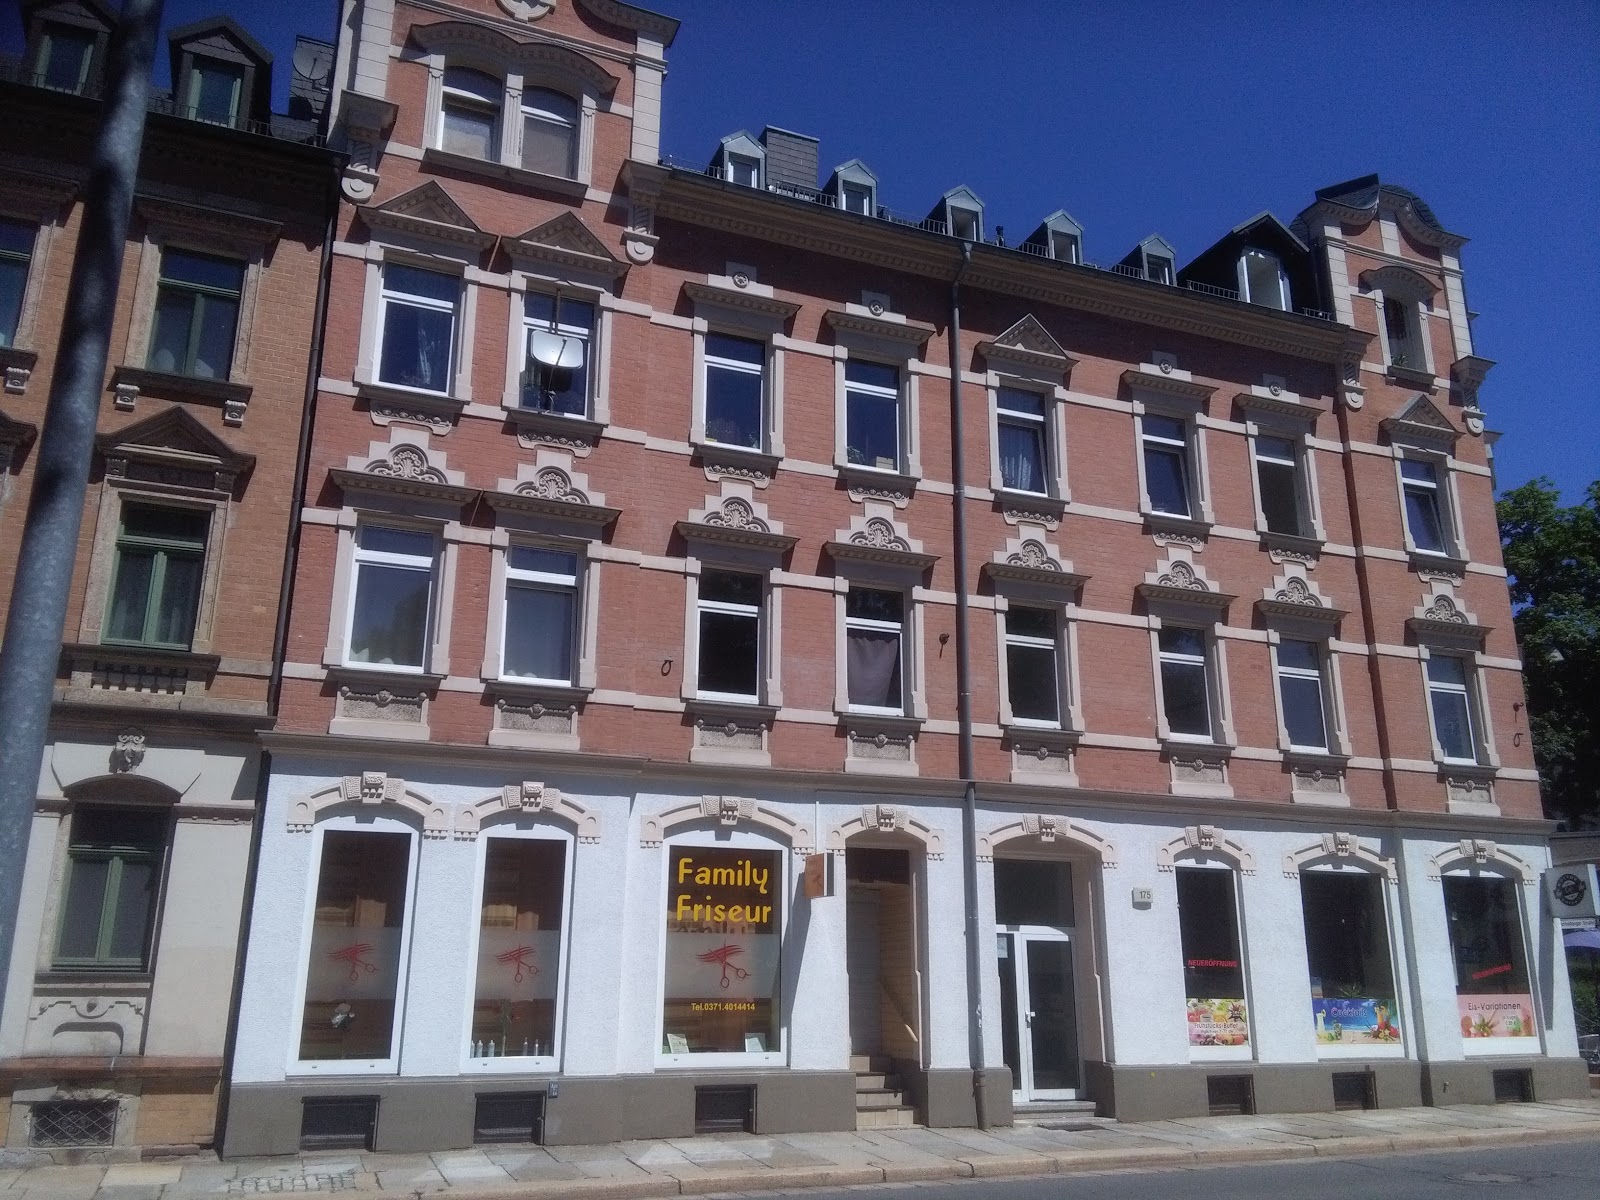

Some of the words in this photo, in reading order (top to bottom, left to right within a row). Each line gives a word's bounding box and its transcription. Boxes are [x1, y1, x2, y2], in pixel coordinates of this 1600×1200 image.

[678, 857, 769, 894] Family
[1139, 890, 1152, 899] 175
[676, 894, 772, 923] Friseur
[1188, 959, 1237, 967] NEUERÖFFNUNG
[691, 1002, 755, 1011] Tel.0371.4014414
[1468, 1002, 1521, 1011] Eis-Variationen
